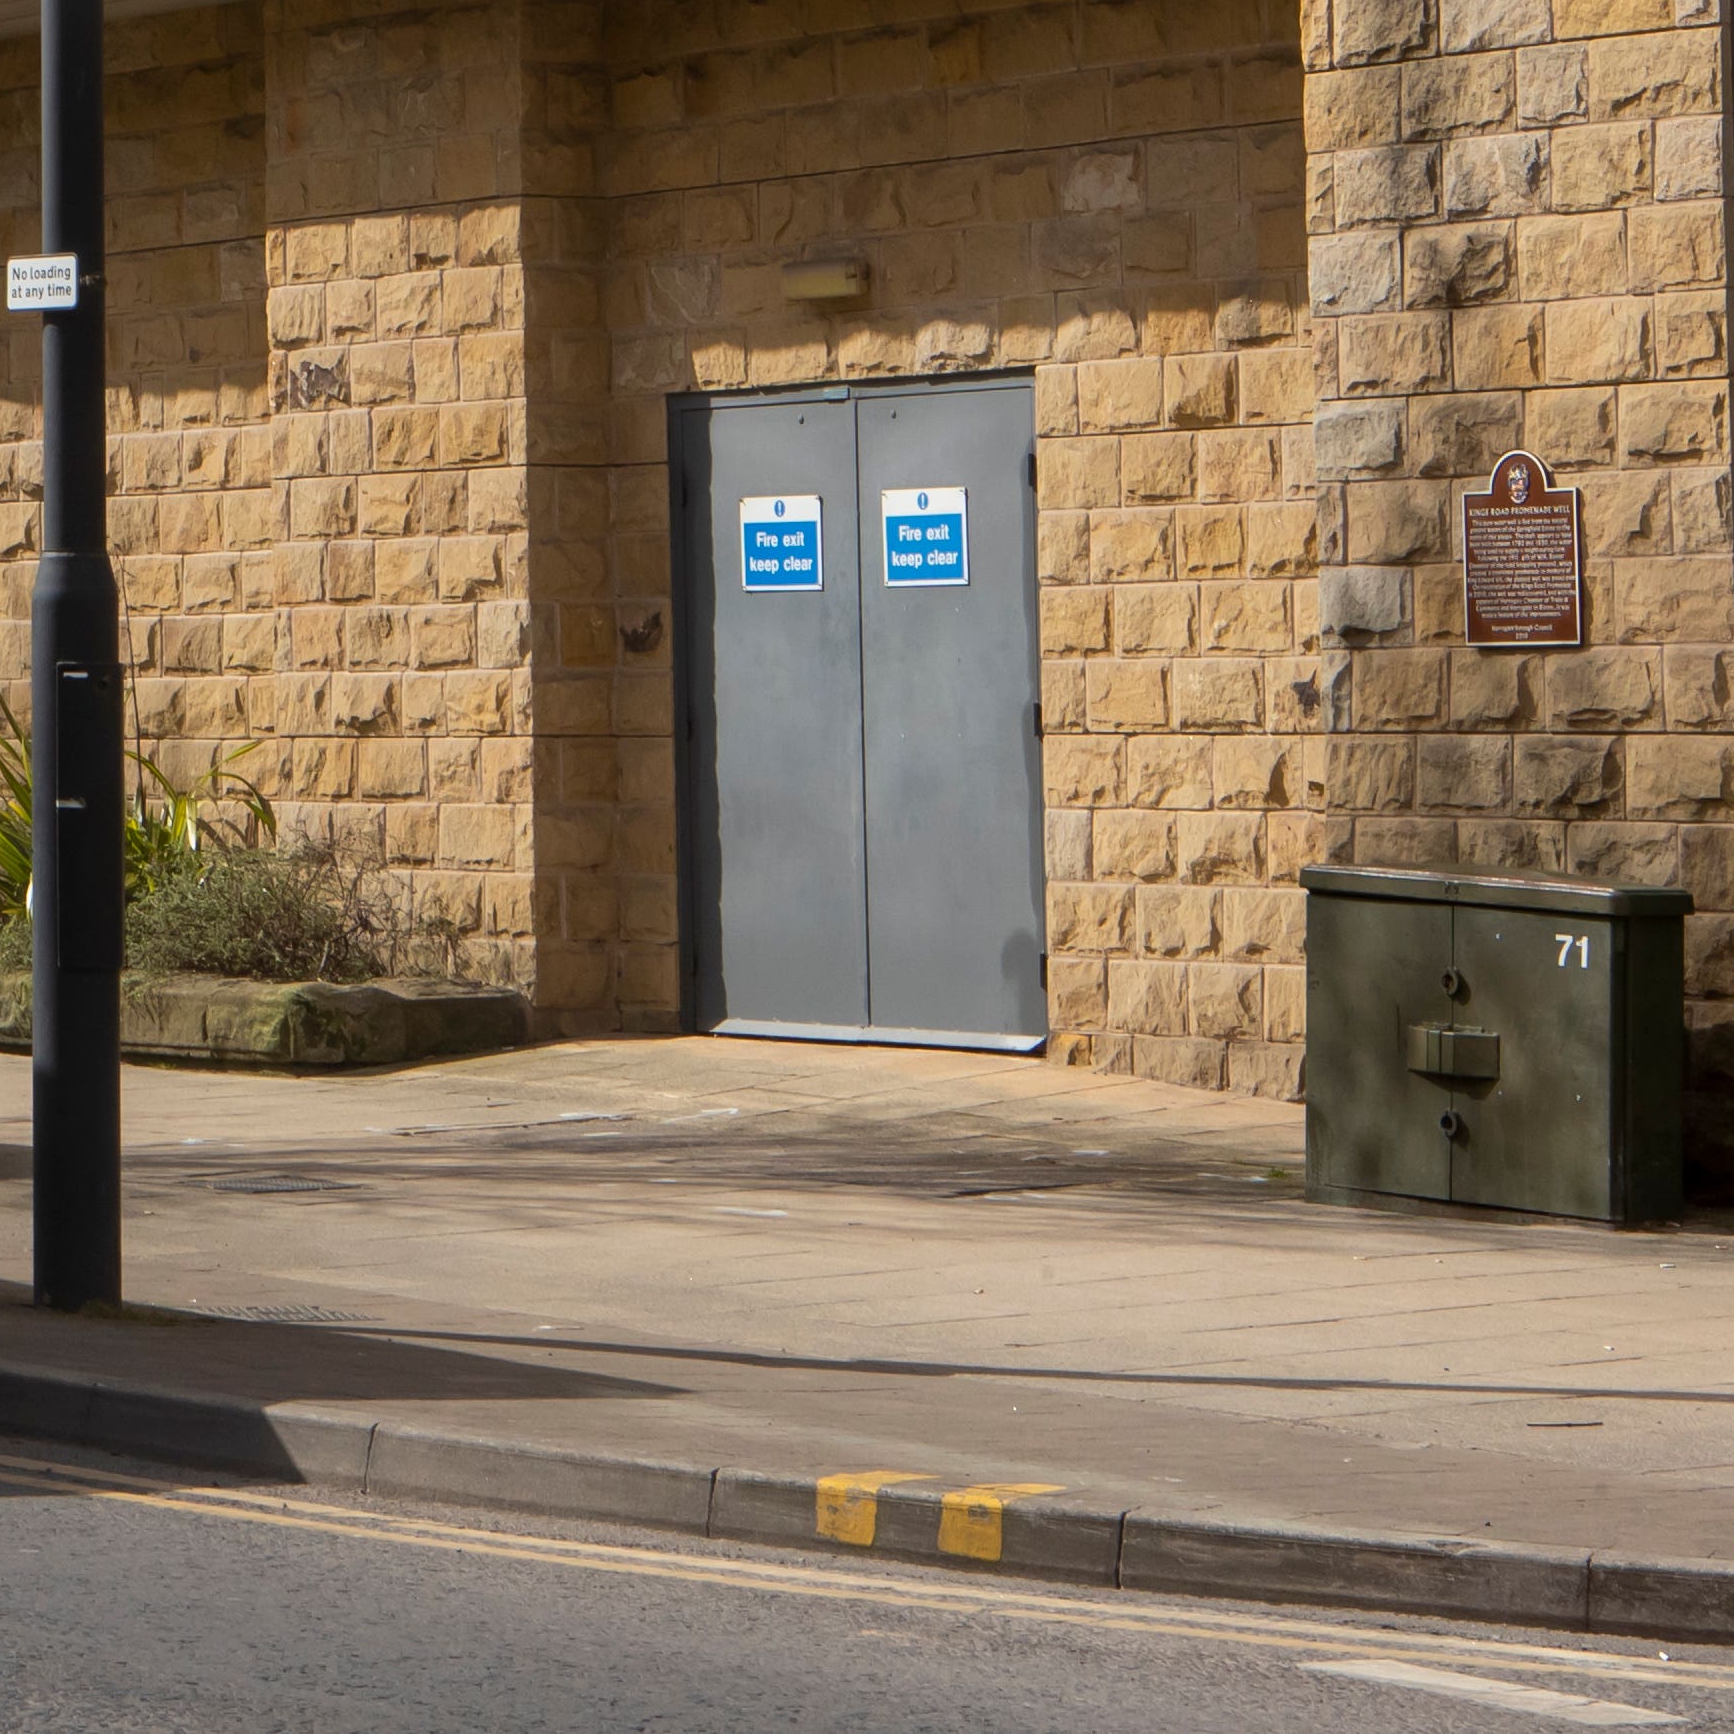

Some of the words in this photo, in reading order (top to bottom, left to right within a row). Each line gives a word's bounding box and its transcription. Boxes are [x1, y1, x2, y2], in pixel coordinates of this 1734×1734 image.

[12, 267, 28, 280] No
[30, 266, 71, 280] loading
[12, 286, 22, 298] at
[25, 287, 44, 300] any
[47, 283, 72, 297] time
[1490, 507, 1510, 516] ROAD
[1553, 505, 1570, 514] WELL
[756, 531, 779, 548] Fire
[783, 530, 805, 547] exit
[898, 524, 923, 542] Fire
[926, 523, 950, 541] exit
[749, 556, 779, 574] keep
[783, 556, 813, 571] clear
[892, 551, 923, 569] keep
[927, 549, 958, 566] clear
[1555, 933, 1589, 969] 71
